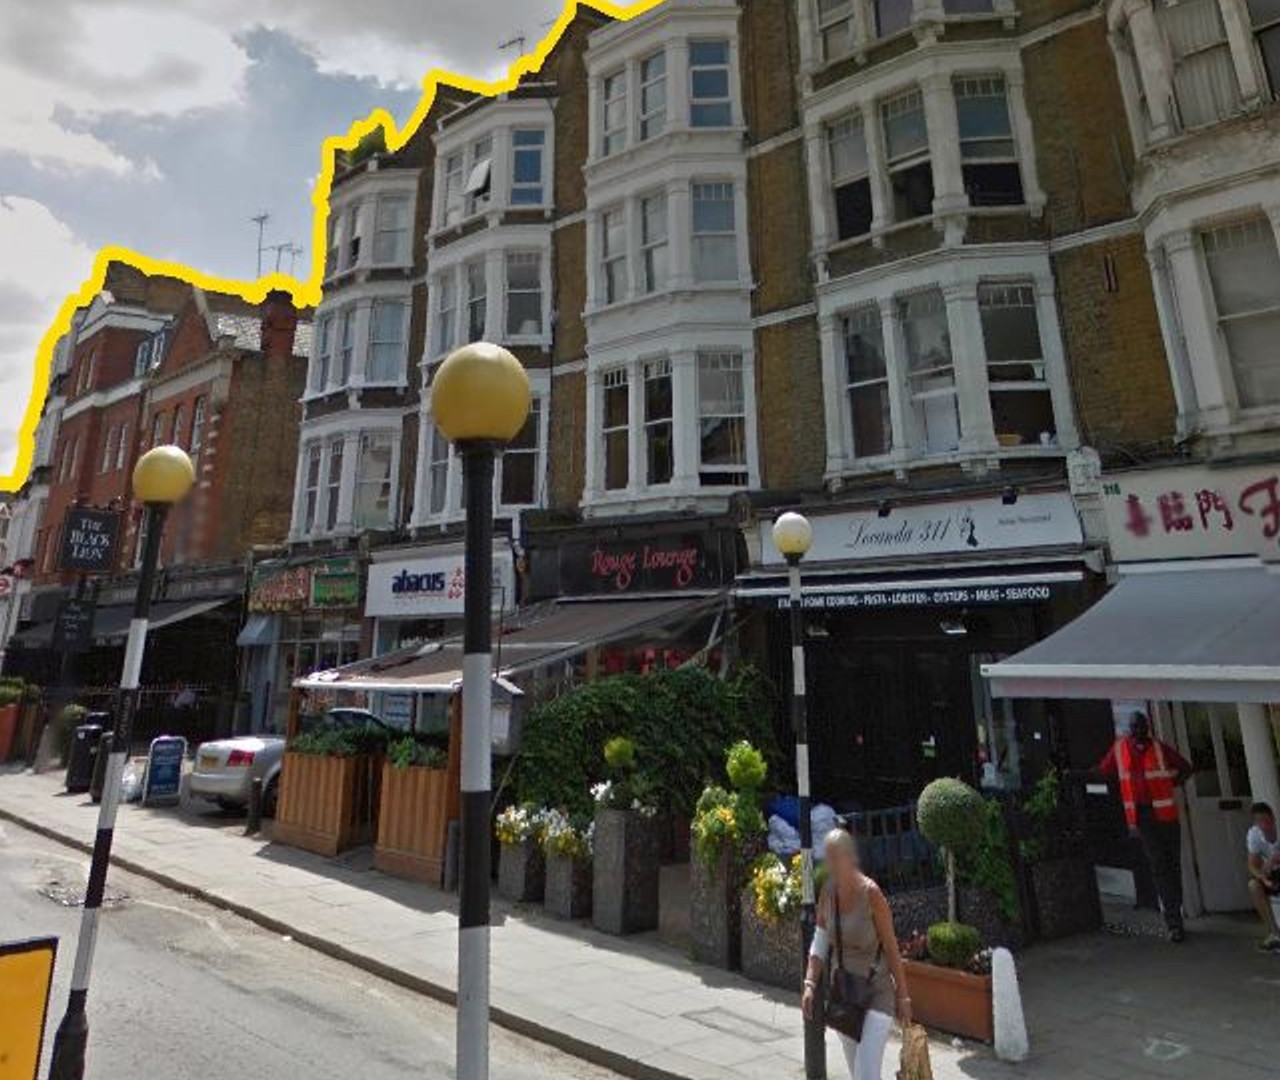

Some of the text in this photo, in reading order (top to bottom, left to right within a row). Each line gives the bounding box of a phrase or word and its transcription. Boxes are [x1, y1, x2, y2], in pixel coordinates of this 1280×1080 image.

[70, 530, 110, 548] BLACK
[845, 520, 912, 549] Locanda
[591, 546, 698, 590] Rouge Lounge
[392, 570, 446, 593] abacus
[1006, 587, 1050, 600] SEAFOOD
